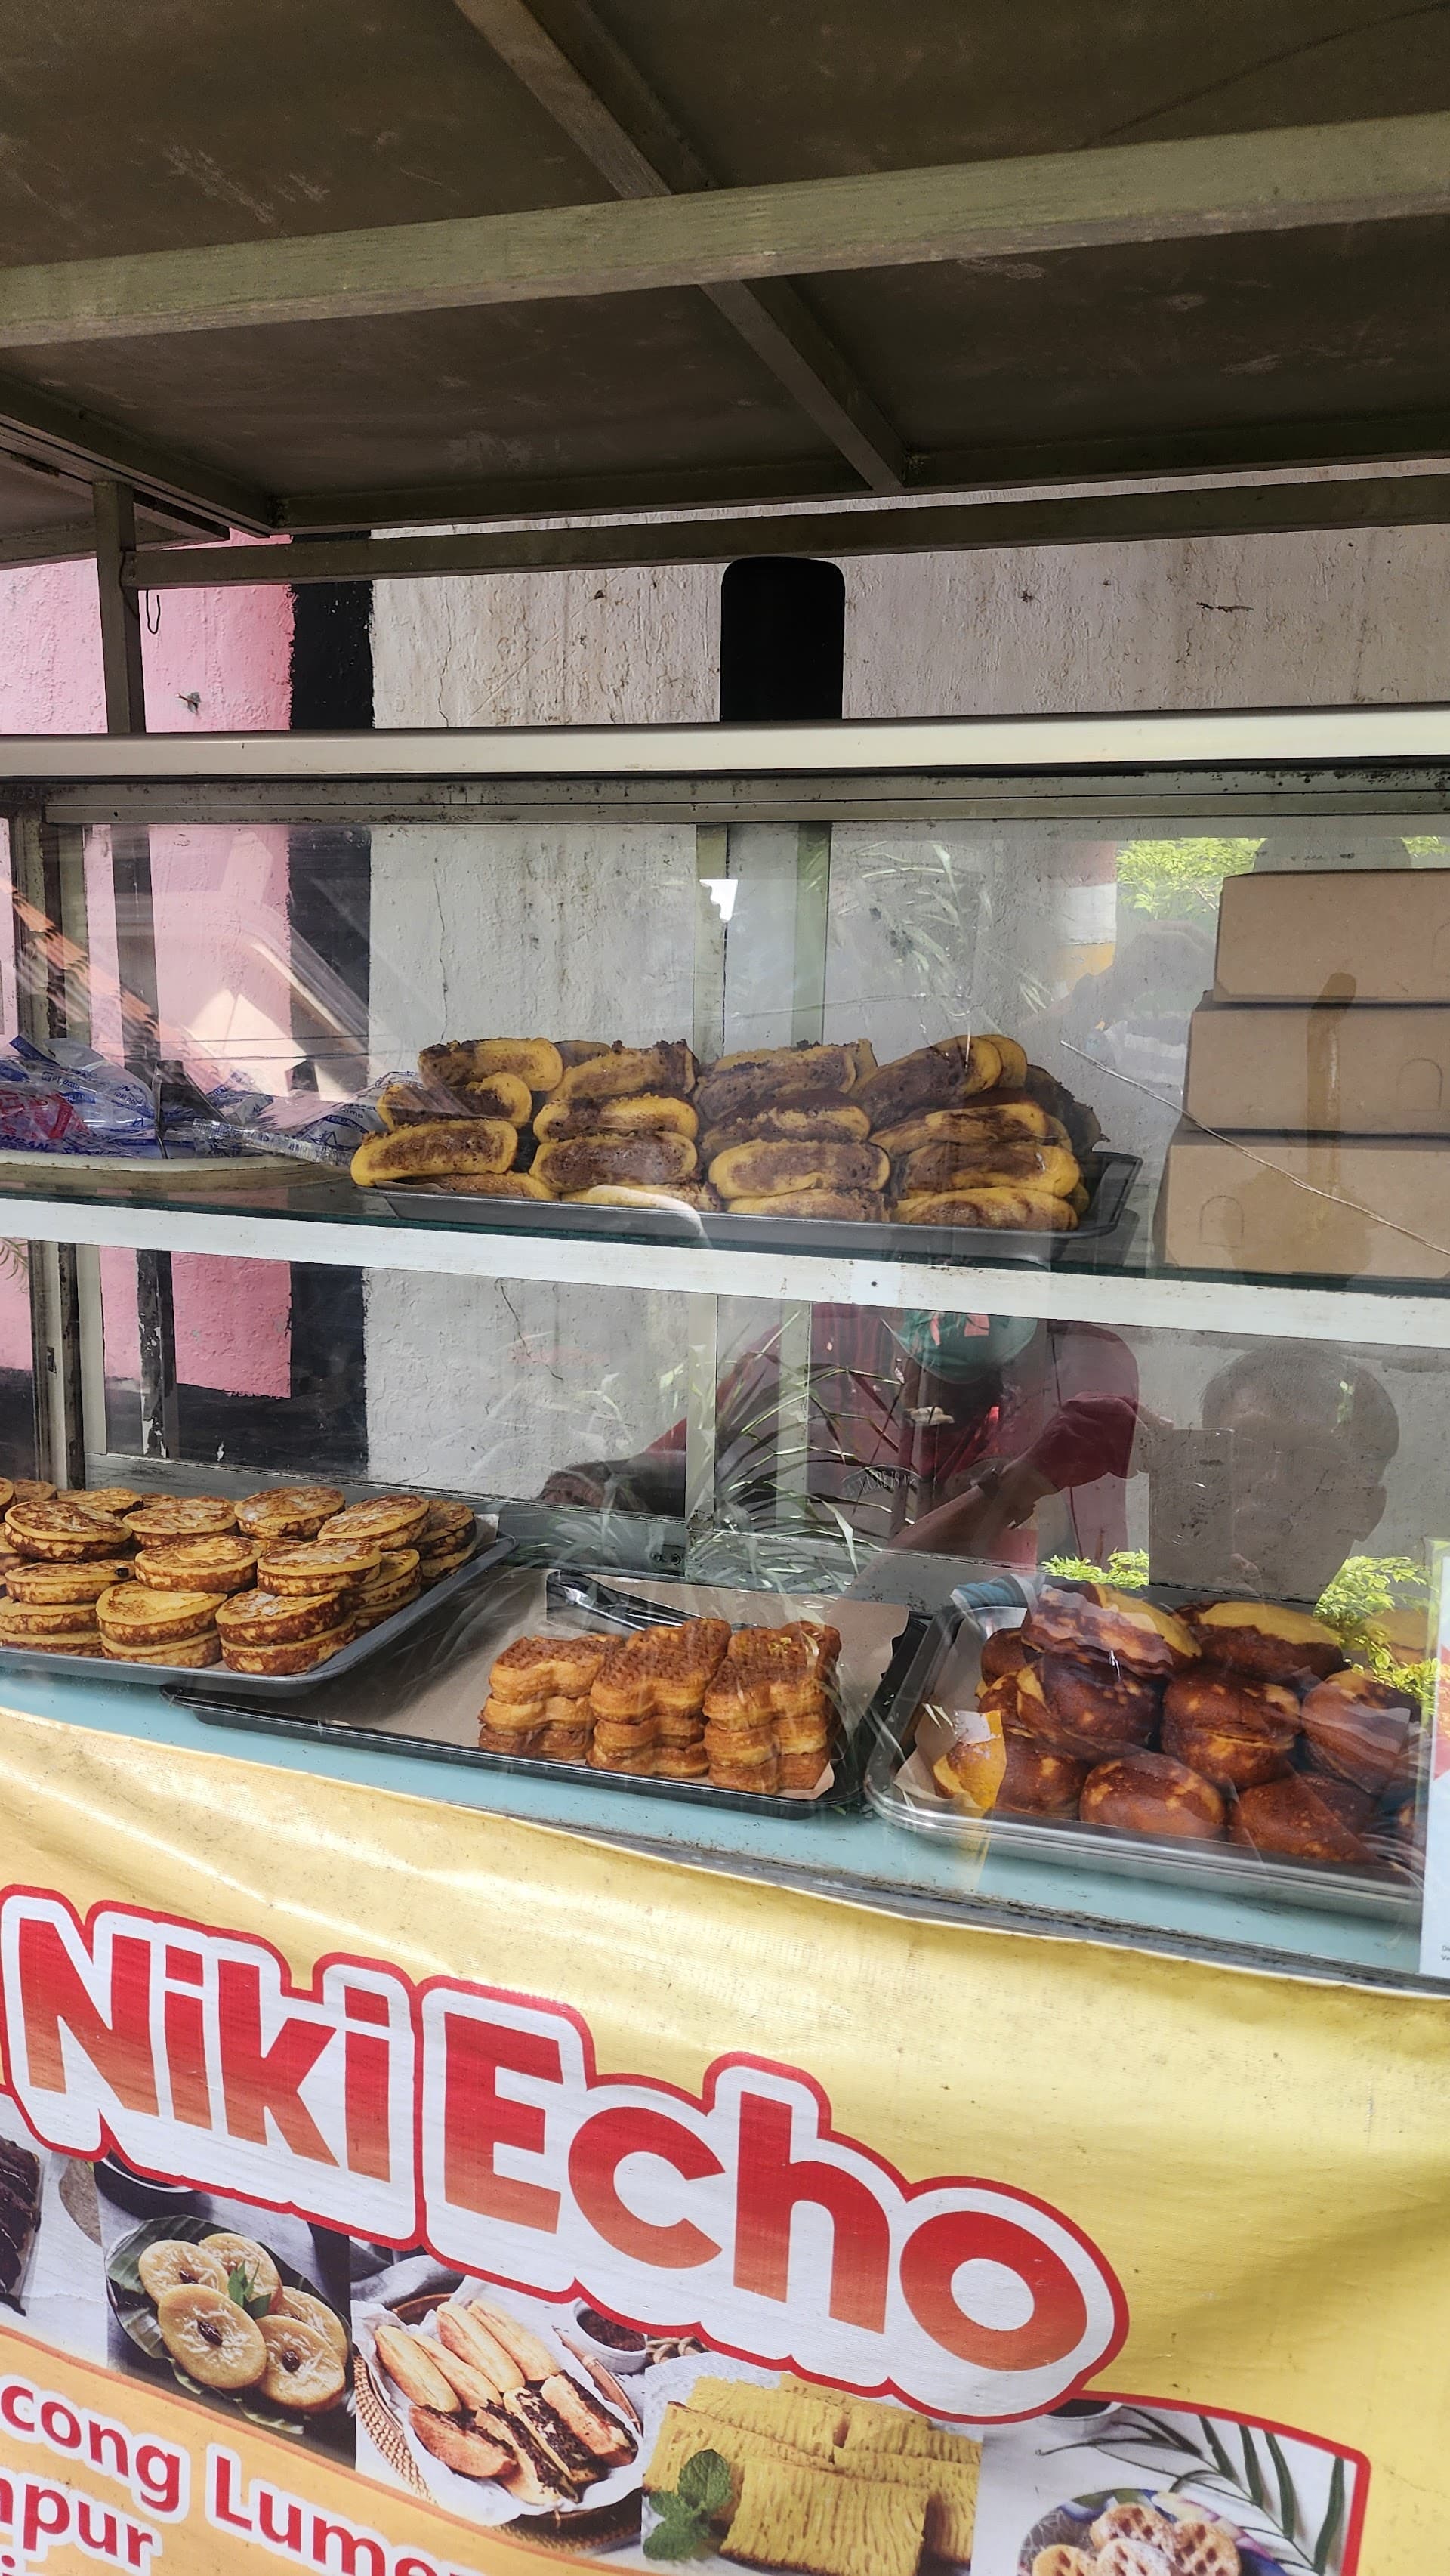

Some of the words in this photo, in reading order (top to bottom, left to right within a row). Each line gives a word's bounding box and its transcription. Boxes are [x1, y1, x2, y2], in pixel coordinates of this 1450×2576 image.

[19, 1917, 392, 2184] Niki
[445, 2012, 1088, 2372] Echo
[0, 2477, 153, 2568] pur
[1, 2386, 180, 2513] cong
[215, 2455, 462, 2576] Lum
